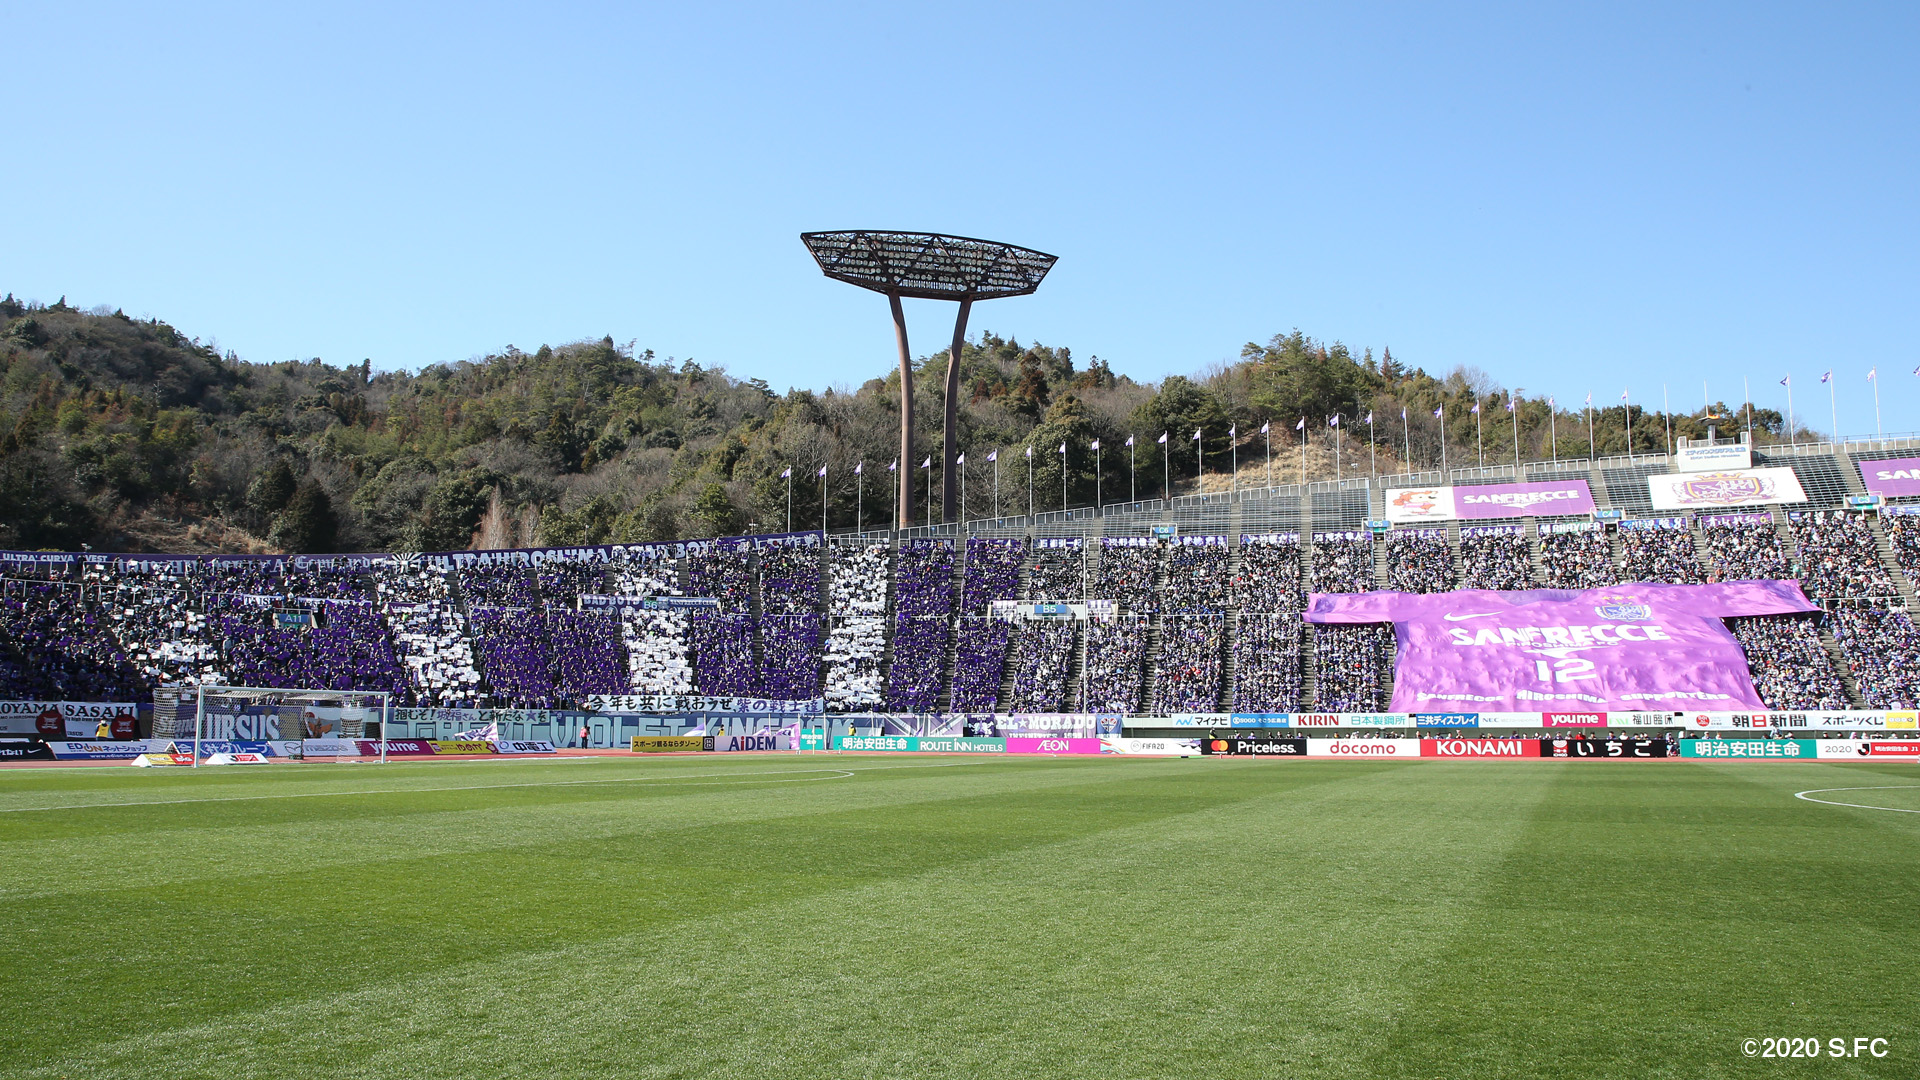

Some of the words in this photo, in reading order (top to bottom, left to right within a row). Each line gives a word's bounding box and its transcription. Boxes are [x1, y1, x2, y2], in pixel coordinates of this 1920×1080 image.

[1463, 489, 1580, 504] SANFRECCE
[1759, 515, 1767, 523] 6
[40, 554, 74, 562] CURVA
[583, 595, 606, 605] BAD
[643, 601, 658, 609] B6
[1042, 604, 1056, 613] B5
[285, 615, 302, 623] A11
[1449, 624, 1672, 646] SANFRECCE
[1535, 658, 1598, 683] 12
[65, 704, 134, 717] SASAKI
[1195, 715, 1228, 726] マイナビ
[1298, 715, 1339, 726] KIRIN
[1351, 715, 1406, 725] 日本製鋼所
[1417, 715, 1477, 725] 三共ディスプレイ
[1551, 714, 1599, 726] youme
[1732, 714, 1807, 727] 朝日新聞
[1822, 715, 1884, 726] スポーツくじ
[513, 742, 552, 752] 中電工
[842, 737, 908, 750] 明治安田生命
[920, 741, 949, 751] ROUTE
[974, 744, 1003, 752] HOTELS
[1237, 741, 1297, 754] Priceless.
[1330, 741, 1396, 755] docomo
[1436, 740, 1522, 756] KONAMI
[1577, 740, 1652, 757] いちご
[1695, 741, 1800, 757] 明治安田生命
[1825, 745, 1852, 753] 2020
